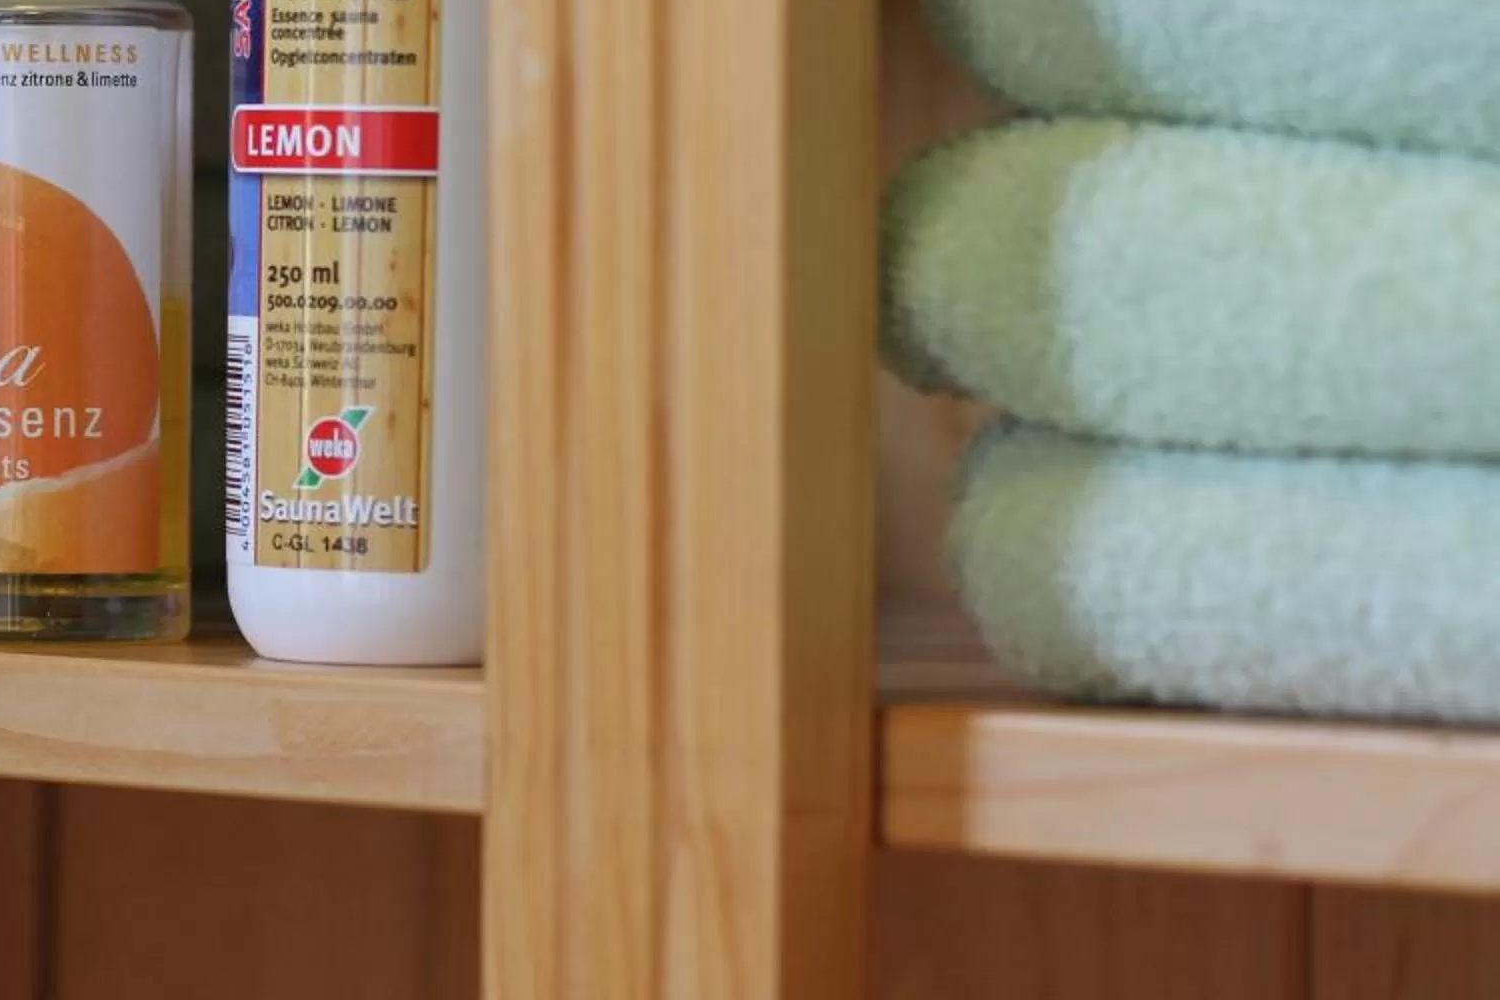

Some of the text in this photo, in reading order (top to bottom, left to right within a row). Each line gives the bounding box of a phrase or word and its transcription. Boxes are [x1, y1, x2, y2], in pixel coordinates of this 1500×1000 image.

[271, 8, 323, 23] Essence
[2, 43, 137, 64] WELLNESS
[21, 70, 73, 87] zitrone
[247, 123, 361, 157] LEMON
[267, 195, 397, 212] LEMON LIMONE
[267, 215, 392, 232] CITRON LEMON
[267, 260, 339, 288] 250 ml
[309, 428, 354, 459] weka
[260, 489, 419, 526] SaunaWelt
